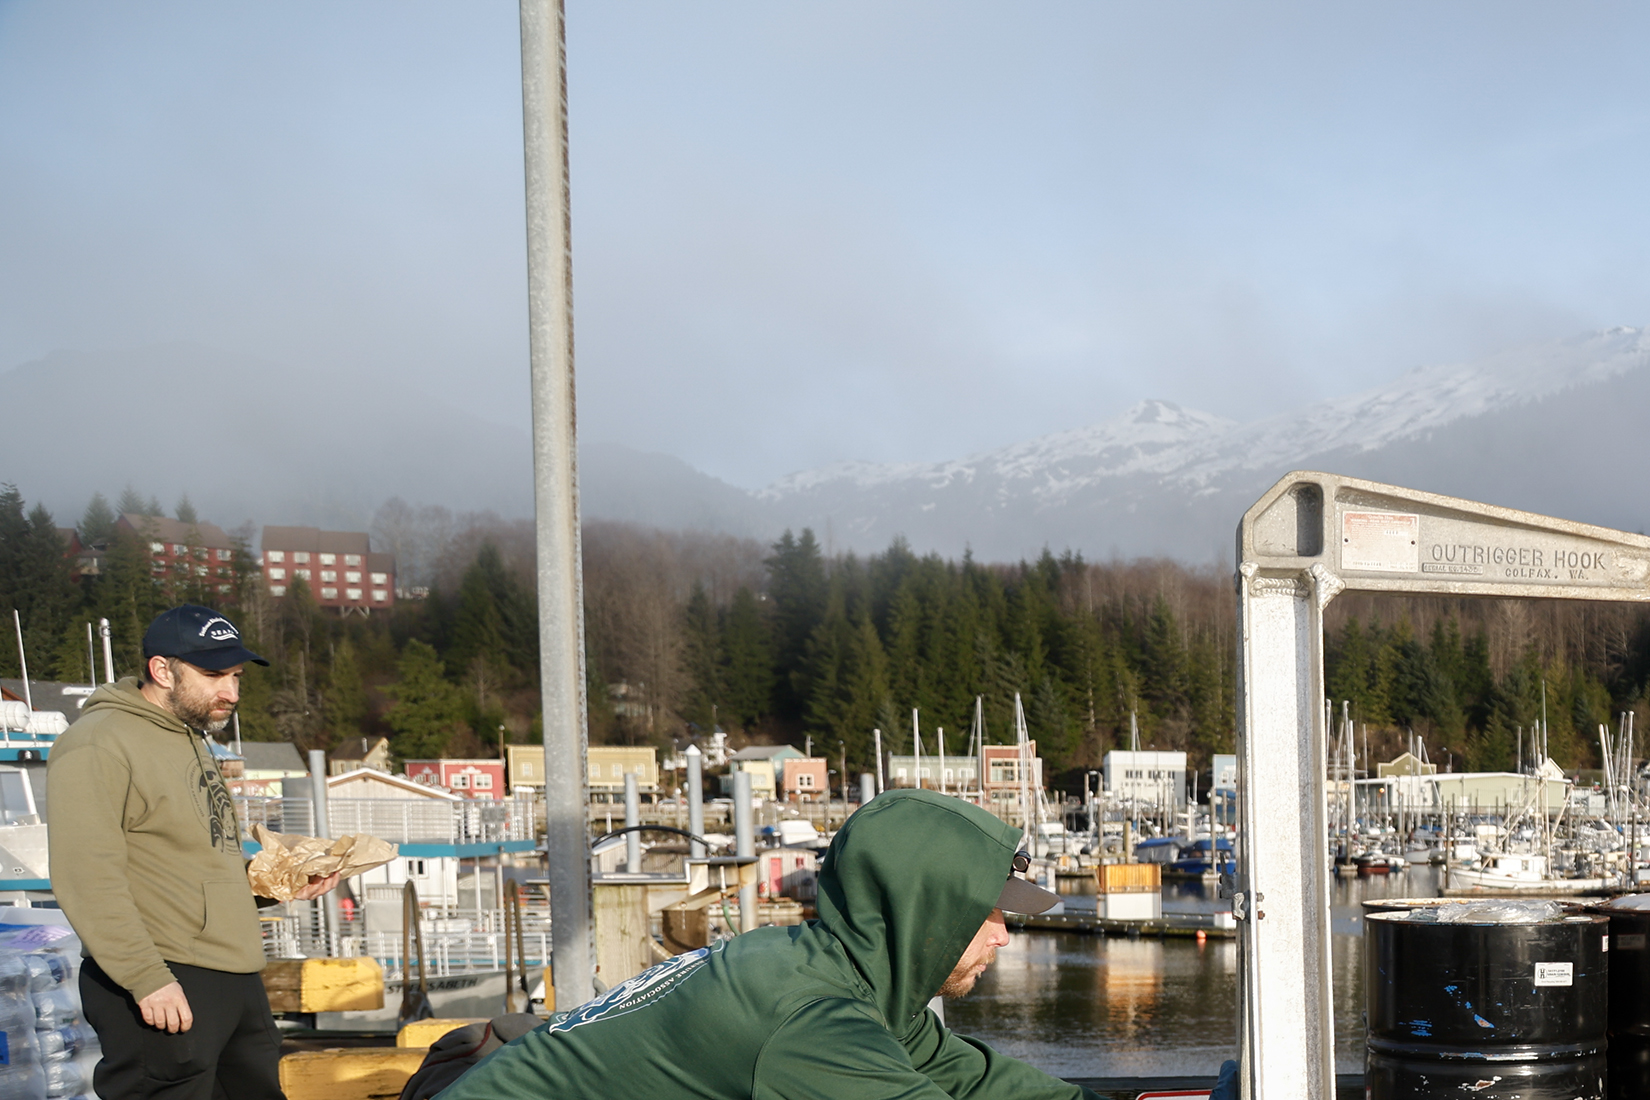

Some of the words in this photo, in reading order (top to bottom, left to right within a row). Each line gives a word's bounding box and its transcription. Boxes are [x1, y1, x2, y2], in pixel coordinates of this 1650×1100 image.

[1432, 543, 1544, 567] OUTRIGGER
[1554, 549, 1607, 570] HOOK
[618, 977, 675, 1010] ASSOCIATION
